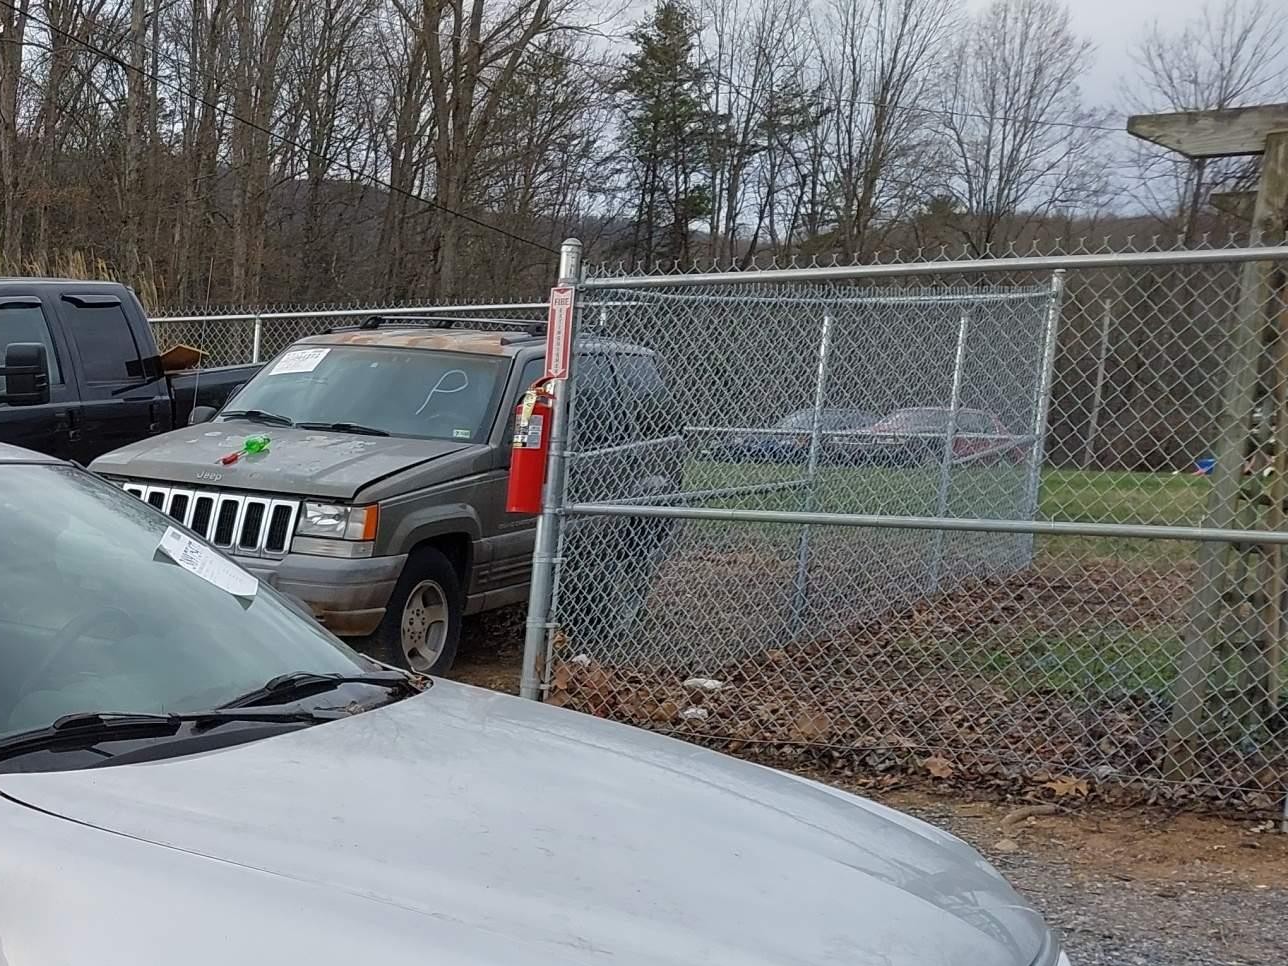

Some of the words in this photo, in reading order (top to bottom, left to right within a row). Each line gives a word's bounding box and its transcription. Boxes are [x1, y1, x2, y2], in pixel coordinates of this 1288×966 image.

[554, 298, 570, 306] FIRE
[415, 369, 469, 415] P
[196, 471, 223, 481] Jeep
